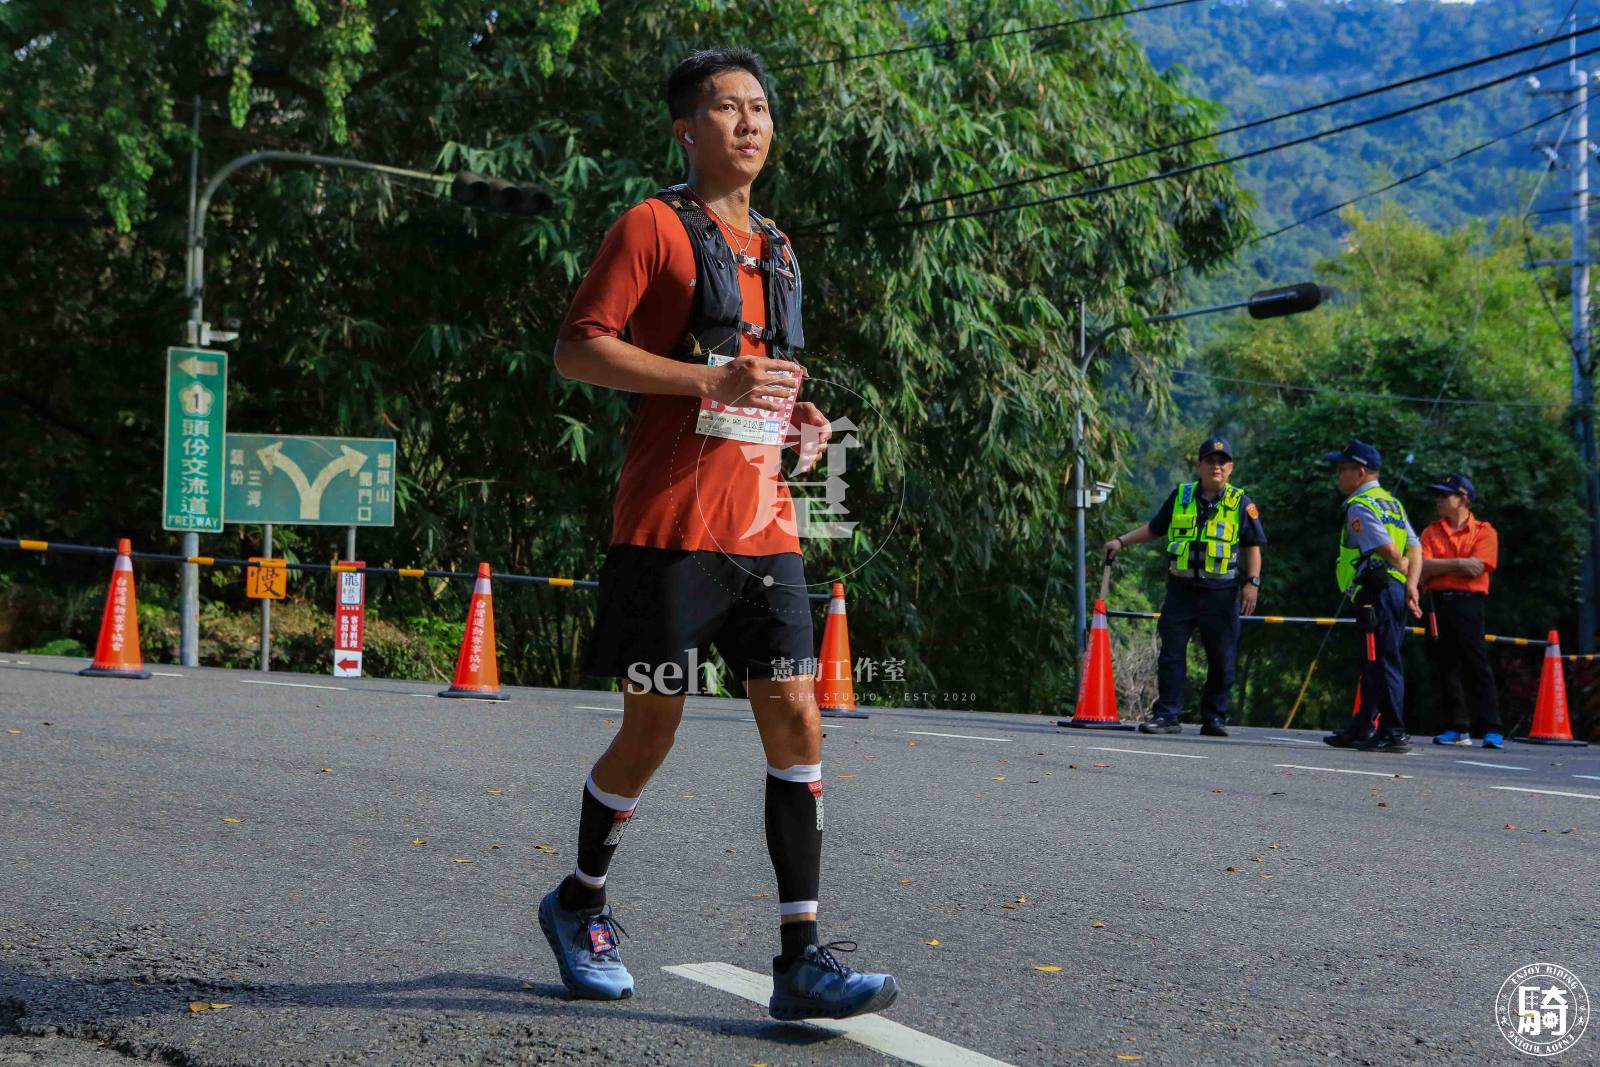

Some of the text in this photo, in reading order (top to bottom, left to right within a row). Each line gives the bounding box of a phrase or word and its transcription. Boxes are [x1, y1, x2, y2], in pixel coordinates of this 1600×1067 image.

[180, 419, 210, 515] 頭份交流道
[167, 515, 219, 529] FREEWAY
